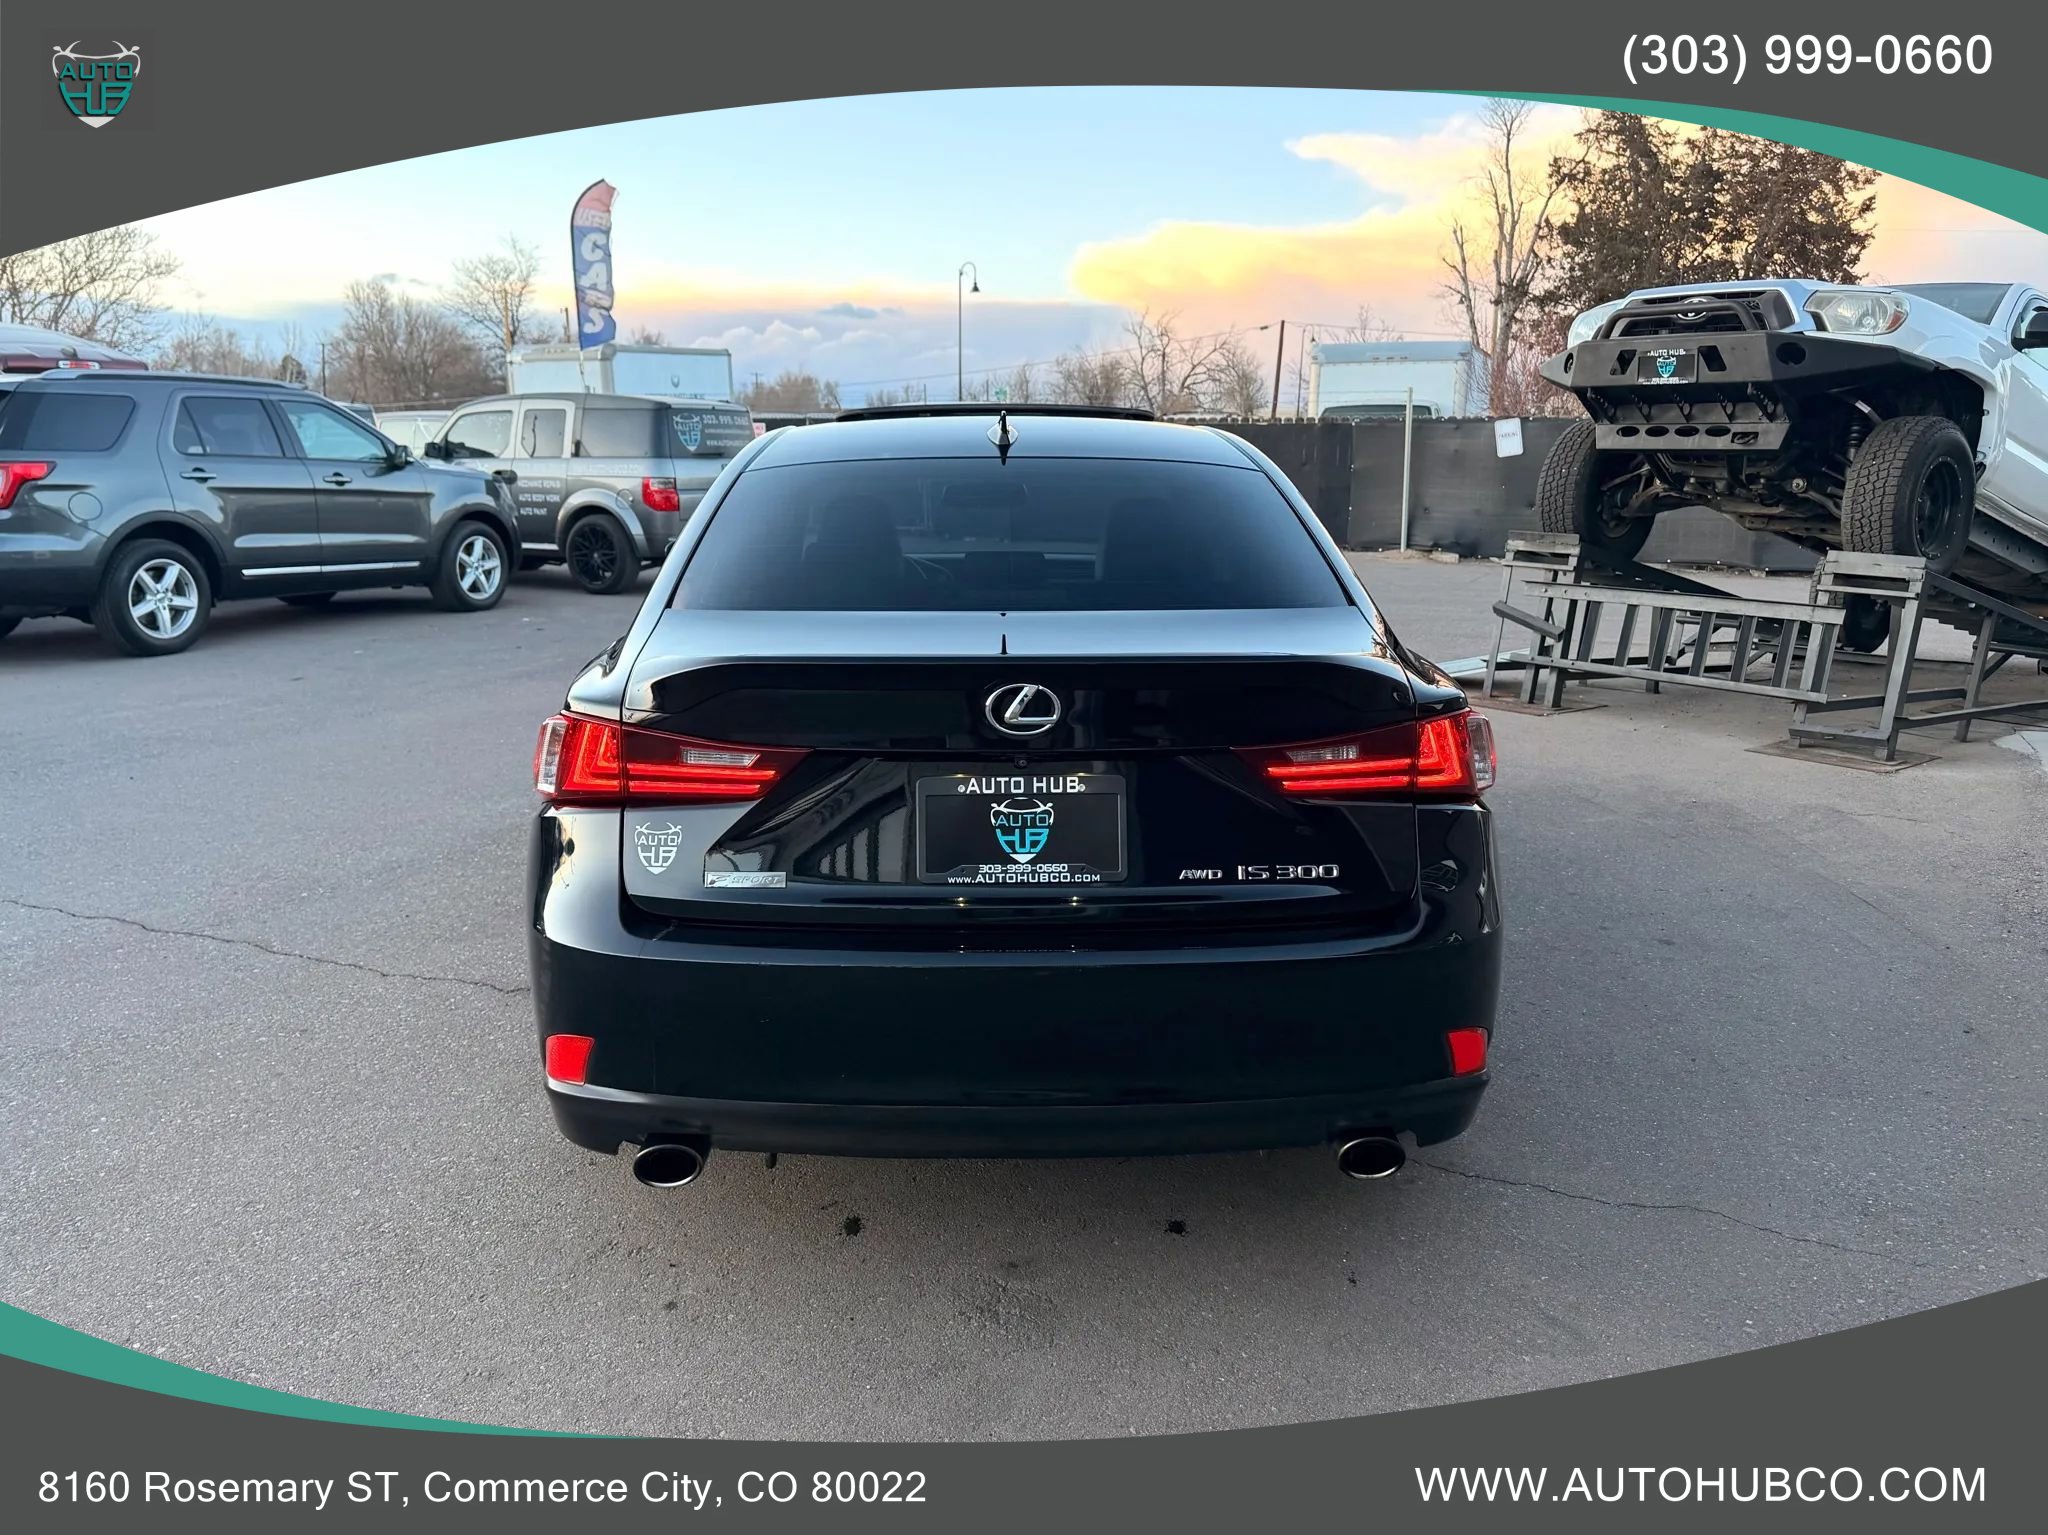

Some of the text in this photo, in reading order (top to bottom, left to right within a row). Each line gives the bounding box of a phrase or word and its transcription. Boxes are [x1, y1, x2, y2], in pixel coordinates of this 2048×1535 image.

[1650, 349, 1667, 357] AUTO
[966, 776, 1079, 794] AUTO HUB
[996, 814, 1049, 826] AUTO
[638, 835, 678, 846] AUTO
[995, 828, 1050, 853] HUB
[637, 847, 678, 867] HUB
[978, 863, 1068, 874] 303-999-0660
[1179, 864, 1340, 880] AWD IS 300
[731, 875, 782, 885] SPORT
